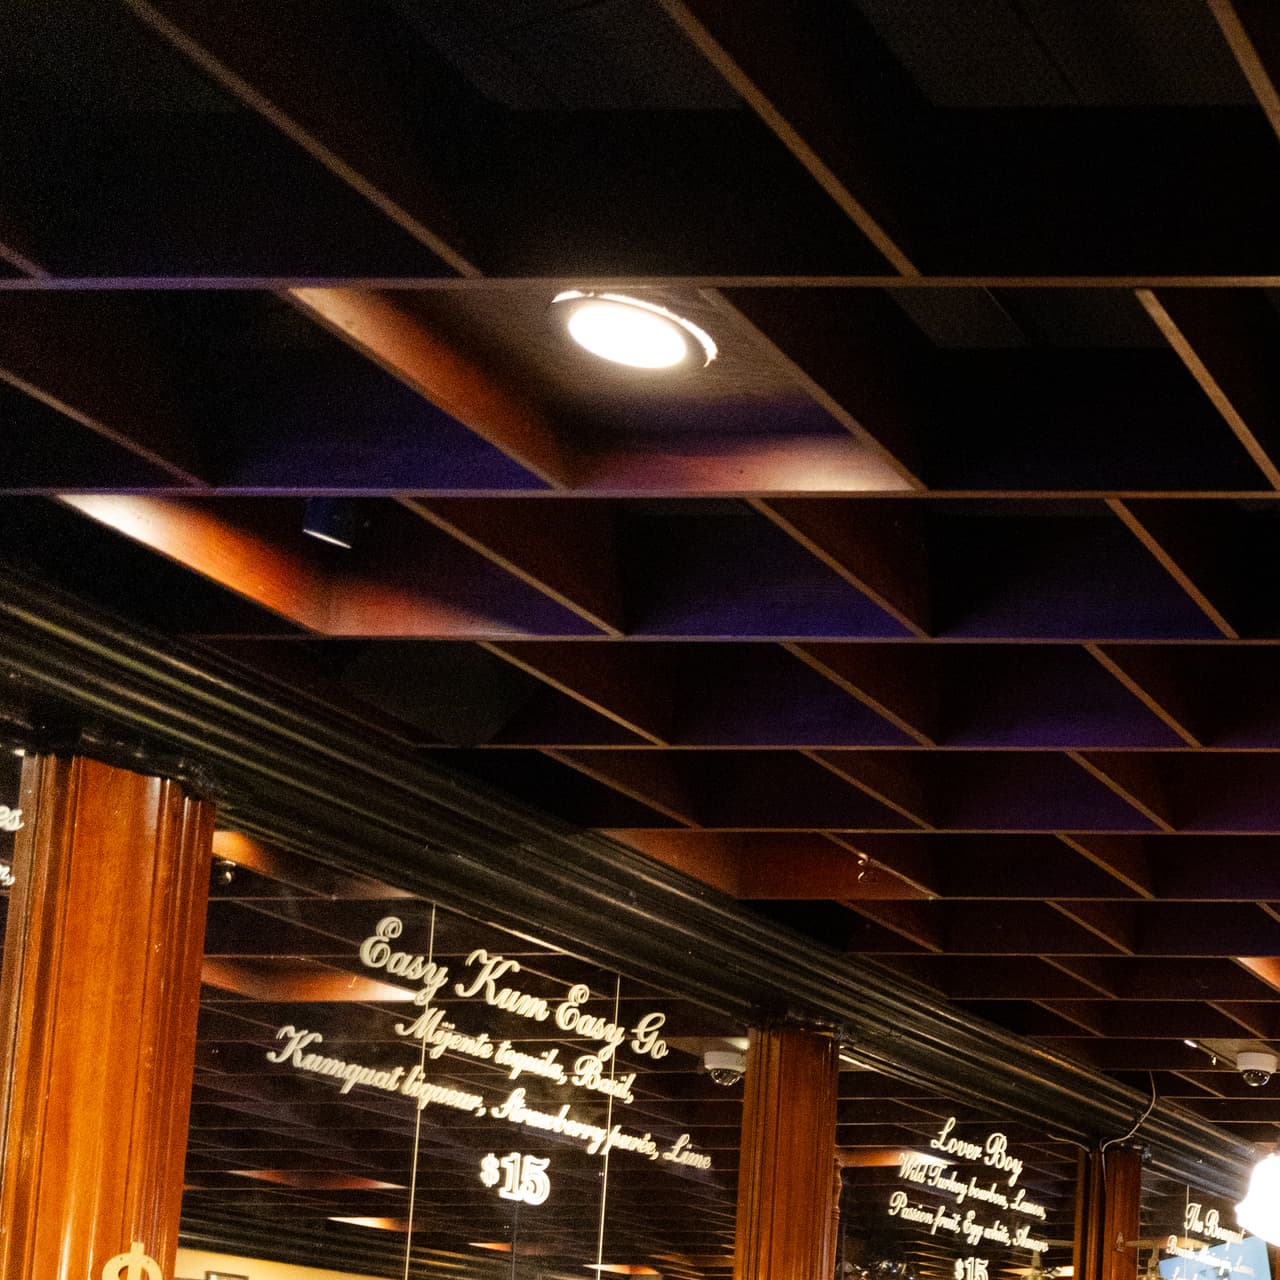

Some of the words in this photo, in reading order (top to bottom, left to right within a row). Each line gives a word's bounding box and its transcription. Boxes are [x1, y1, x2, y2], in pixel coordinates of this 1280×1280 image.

[360, 916, 448, 1005] Easy
[455, 949, 550, 1021] Kum
[556, 984, 625, 1060] Easy
[631, 1012, 668, 1060] Go
[267, 1025, 405, 1095] Kumquat
[404, 1066, 486, 1118] liqueur,
[492, 1087, 606, 1155] Strawberry
[663, 1134, 712, 1170] Lime
[494, 1040, 568, 1086] tequila,
[572, 1055, 636, 1104] Basil,
[480, 1152, 551, 1205] $15
[898, 1153, 928, 1183] Wild
[927, 1163, 968, 1204] Turkey
[930, 1117, 983, 1160] Lover
[984, 1133, 1024, 1187] Boy
[888, 1191, 934, 1225] Passion
[963, 1210, 984, 1246] Egg
